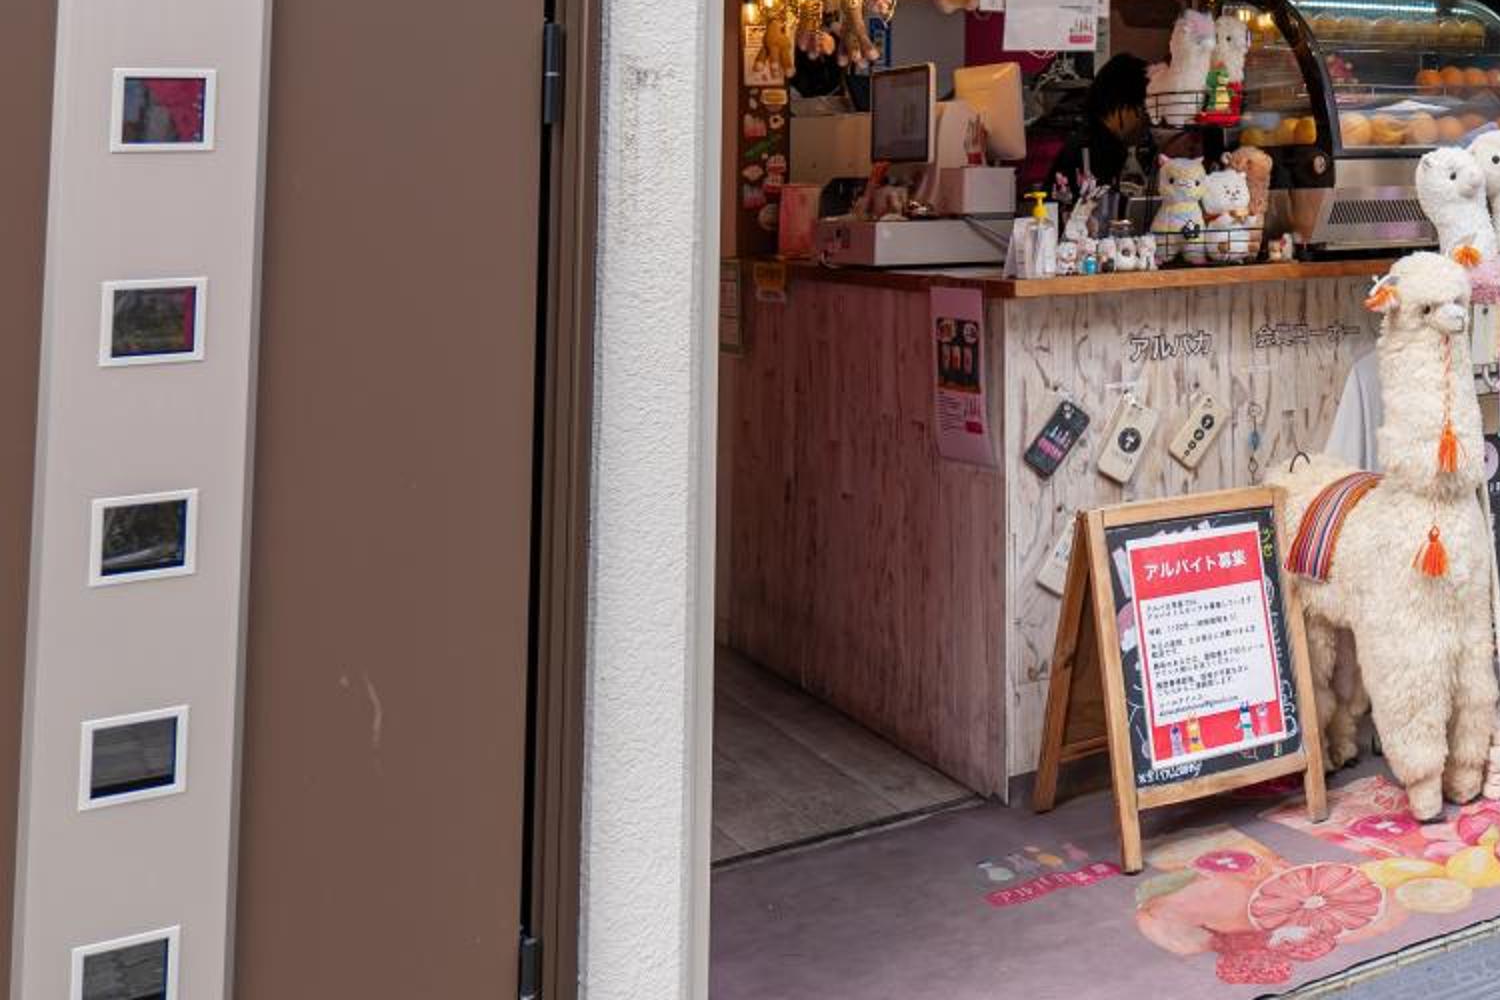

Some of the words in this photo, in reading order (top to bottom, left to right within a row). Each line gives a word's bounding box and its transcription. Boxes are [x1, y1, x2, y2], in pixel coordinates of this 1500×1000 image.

[1143, 548, 1249, 582] アルバイト募集
